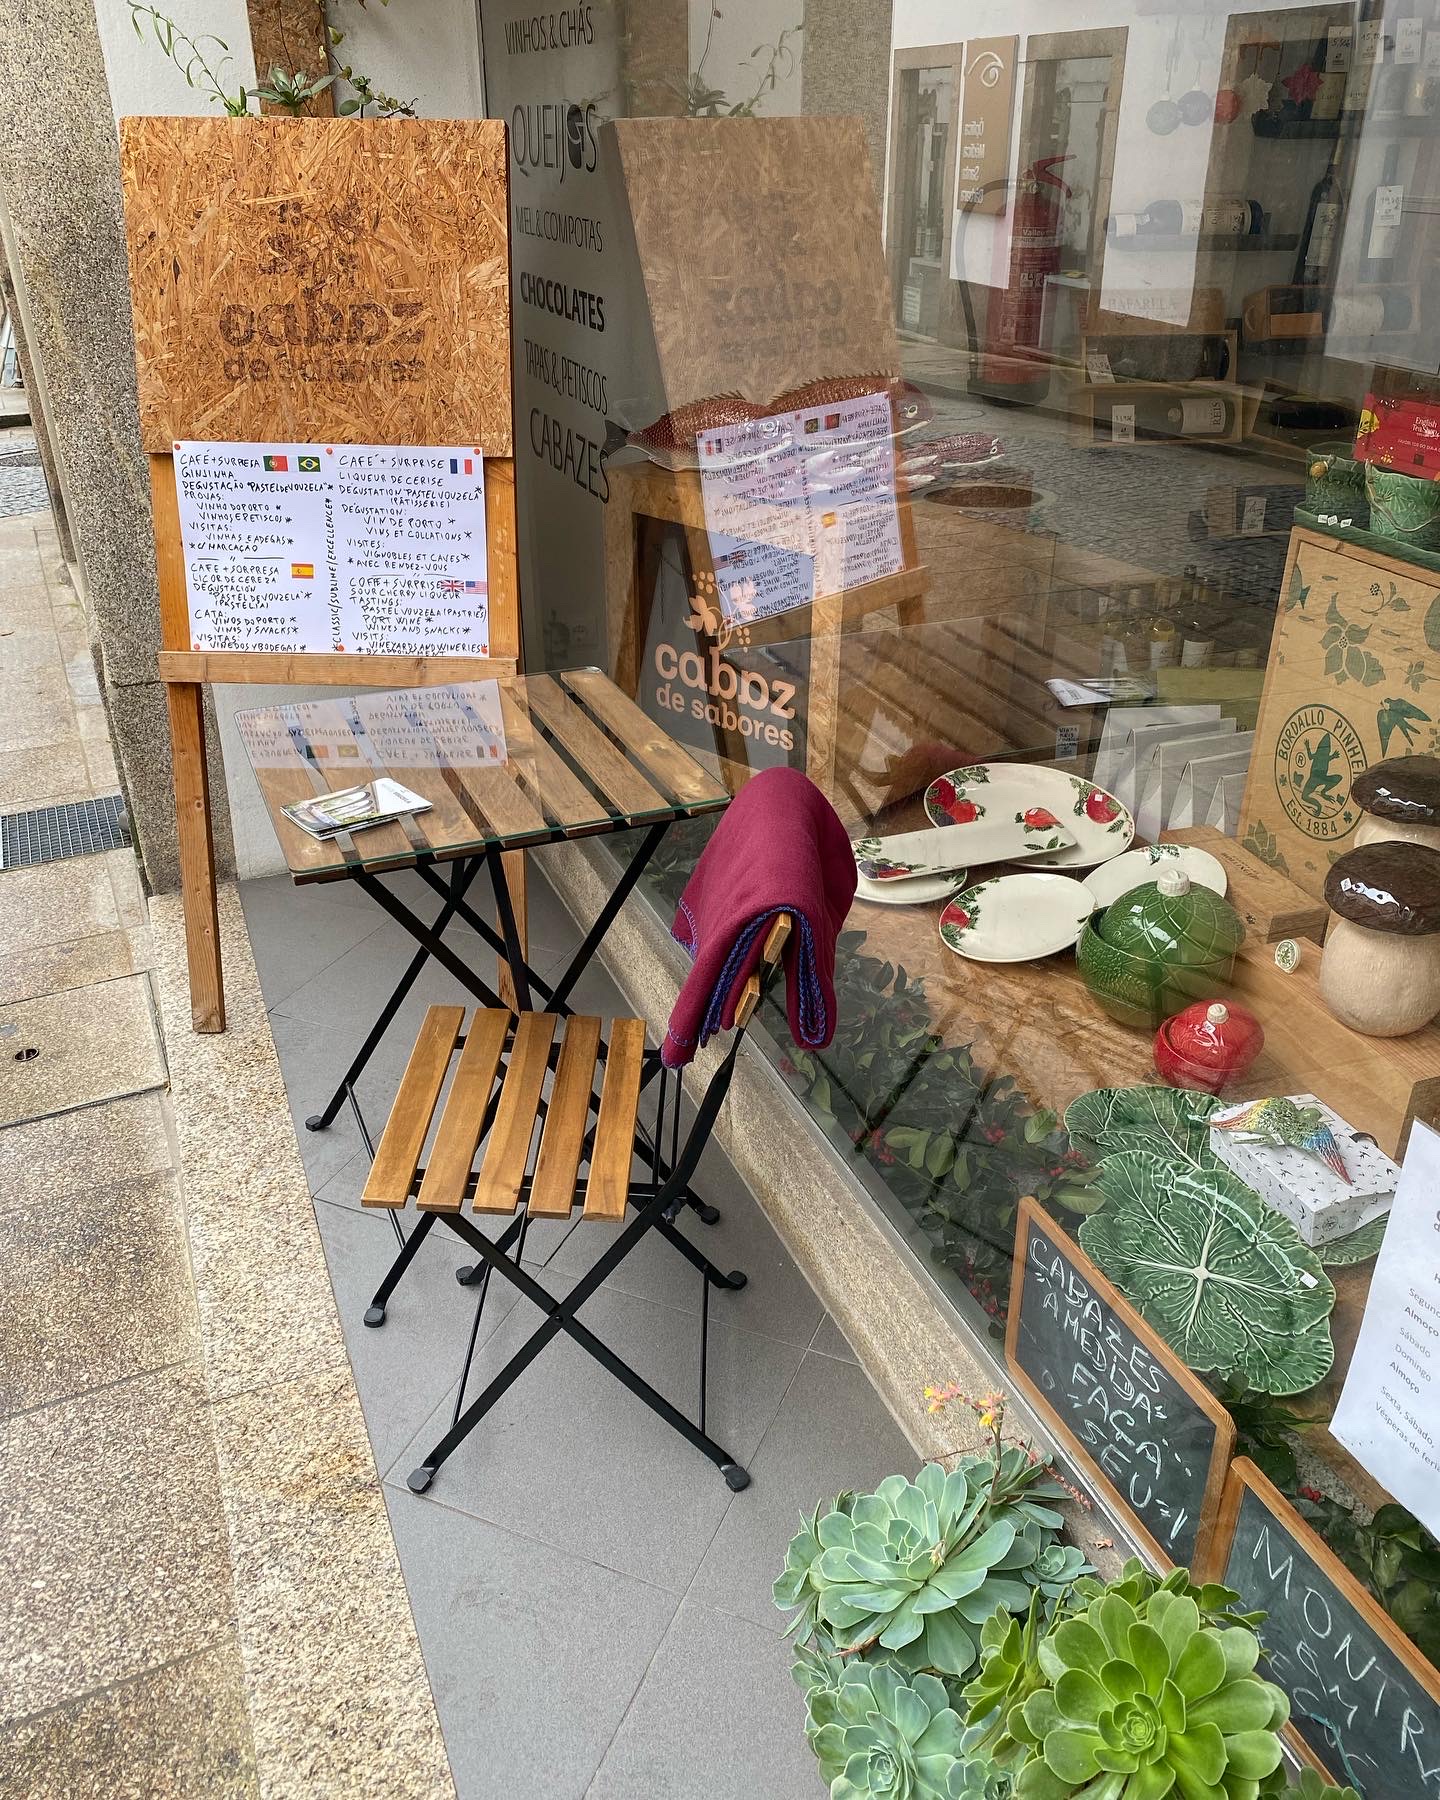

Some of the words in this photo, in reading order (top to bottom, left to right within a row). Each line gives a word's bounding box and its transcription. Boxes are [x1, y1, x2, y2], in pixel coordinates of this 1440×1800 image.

[505, 16, 547, 55] VINHOS
[549, 14, 558, 49] &
[559, 0, 595, 49] CHÁS
[515, 205, 536, 236] MEL
[536, 209, 543, 239] &
[544, 211, 603, 251] COMPOTAS
[520, 271, 605, 333] CHOCOLATES
[524, 339, 551, 385] TAPAS
[552, 352, 562, 396] &
[562, 356, 608, 416] PETISCOS
[530, 408, 610, 504] CABAZES
[391, 457, 445, 469] SURPRISE
[182, 466, 234, 479] GINJINHA
[339, 472, 387, 483] LIQUEUR
[391, 475, 401, 484] DE
[405, 476, 444, 487] CERISE
[184, 490, 224, 501] PROVAS:
[188, 522, 232, 533] VISITAS:
[364, 516, 387, 525] VIN
[389, 518, 403, 528] DE
[408, 517, 442, 529] PORTO
[206, 533, 242, 542] VINHAS
[253, 535, 286, 546] ADEGAS
[365, 527, 390, 538] VINS
[394, 529, 404, 538] ET
[407, 530, 462, 541] COLLATIONS
[346, 538, 385, 549] VISITES:
[363, 550, 412, 561] VIGNOBLES
[416, 553, 427, 561] ET
[430, 553, 461, 563] CAVES
[230, 564, 279, 576] SORPRESA
[356, 560, 379, 569] AVEC
[385, 560, 448, 572] RENDEZ-VOUS
[192, 573, 221, 583] LICOR
[224, 576, 235, 584] DE
[238, 574, 277, 584] CEREZA
[392, 578, 442, 590] SURPRISE
[351, 587, 377, 596] SOUR
[380, 588, 416, 600] CHERRY
[420, 590, 461, 600] LIQUEUR
[349, 596, 403, 607] TASTINGS:
[194, 609, 227, 619] CATA:
[361, 605, 399, 615] PASTEL
[212, 616, 241, 626] VINOS
[257, 616, 285, 625] PORTO
[396, 616, 422, 626] WINE
[214, 626, 242, 635] VINOS
[254, 626, 291, 636] SNACKS
[366, 623, 398, 633] WINES
[402, 626, 421, 635] AND
[425, 626, 461, 636] SNACKS
[197, 633, 240, 644] VISITAS:
[352, 632, 389, 641] VISITS:
[257, 642, 297, 652] BODEGAS
[369, 641, 418, 652] VINEYARDS
[438, 643, 481, 653] WINERIES
[656, 683, 686, 713] de
[691, 699, 794, 751] sabores
[1278, 709, 1324, 760] BORDALLO
[1306, 818, 1338, 836] 1884
[1030, 1237, 1168, 1393] CABAZES
[1404, 1305, 1439, 1338] Almoço
[1399, 1327, 1431, 1359] Sábado
[1395, 1343, 1432, 1382] Domingo
[1389, 1361, 1420, 1395] Almoço
[1071, 1361, 1162, 1481] FAÇA
[1381, 1385, 1403, 1416] Sexta,
[1404, 1410, 1436, 1449] Sábado,
[1375, 1401, 1409, 1443] Vésperas
[1409, 1440, 1420, 1455] de
[1253, 1525, 1440, 1785] MONTR
